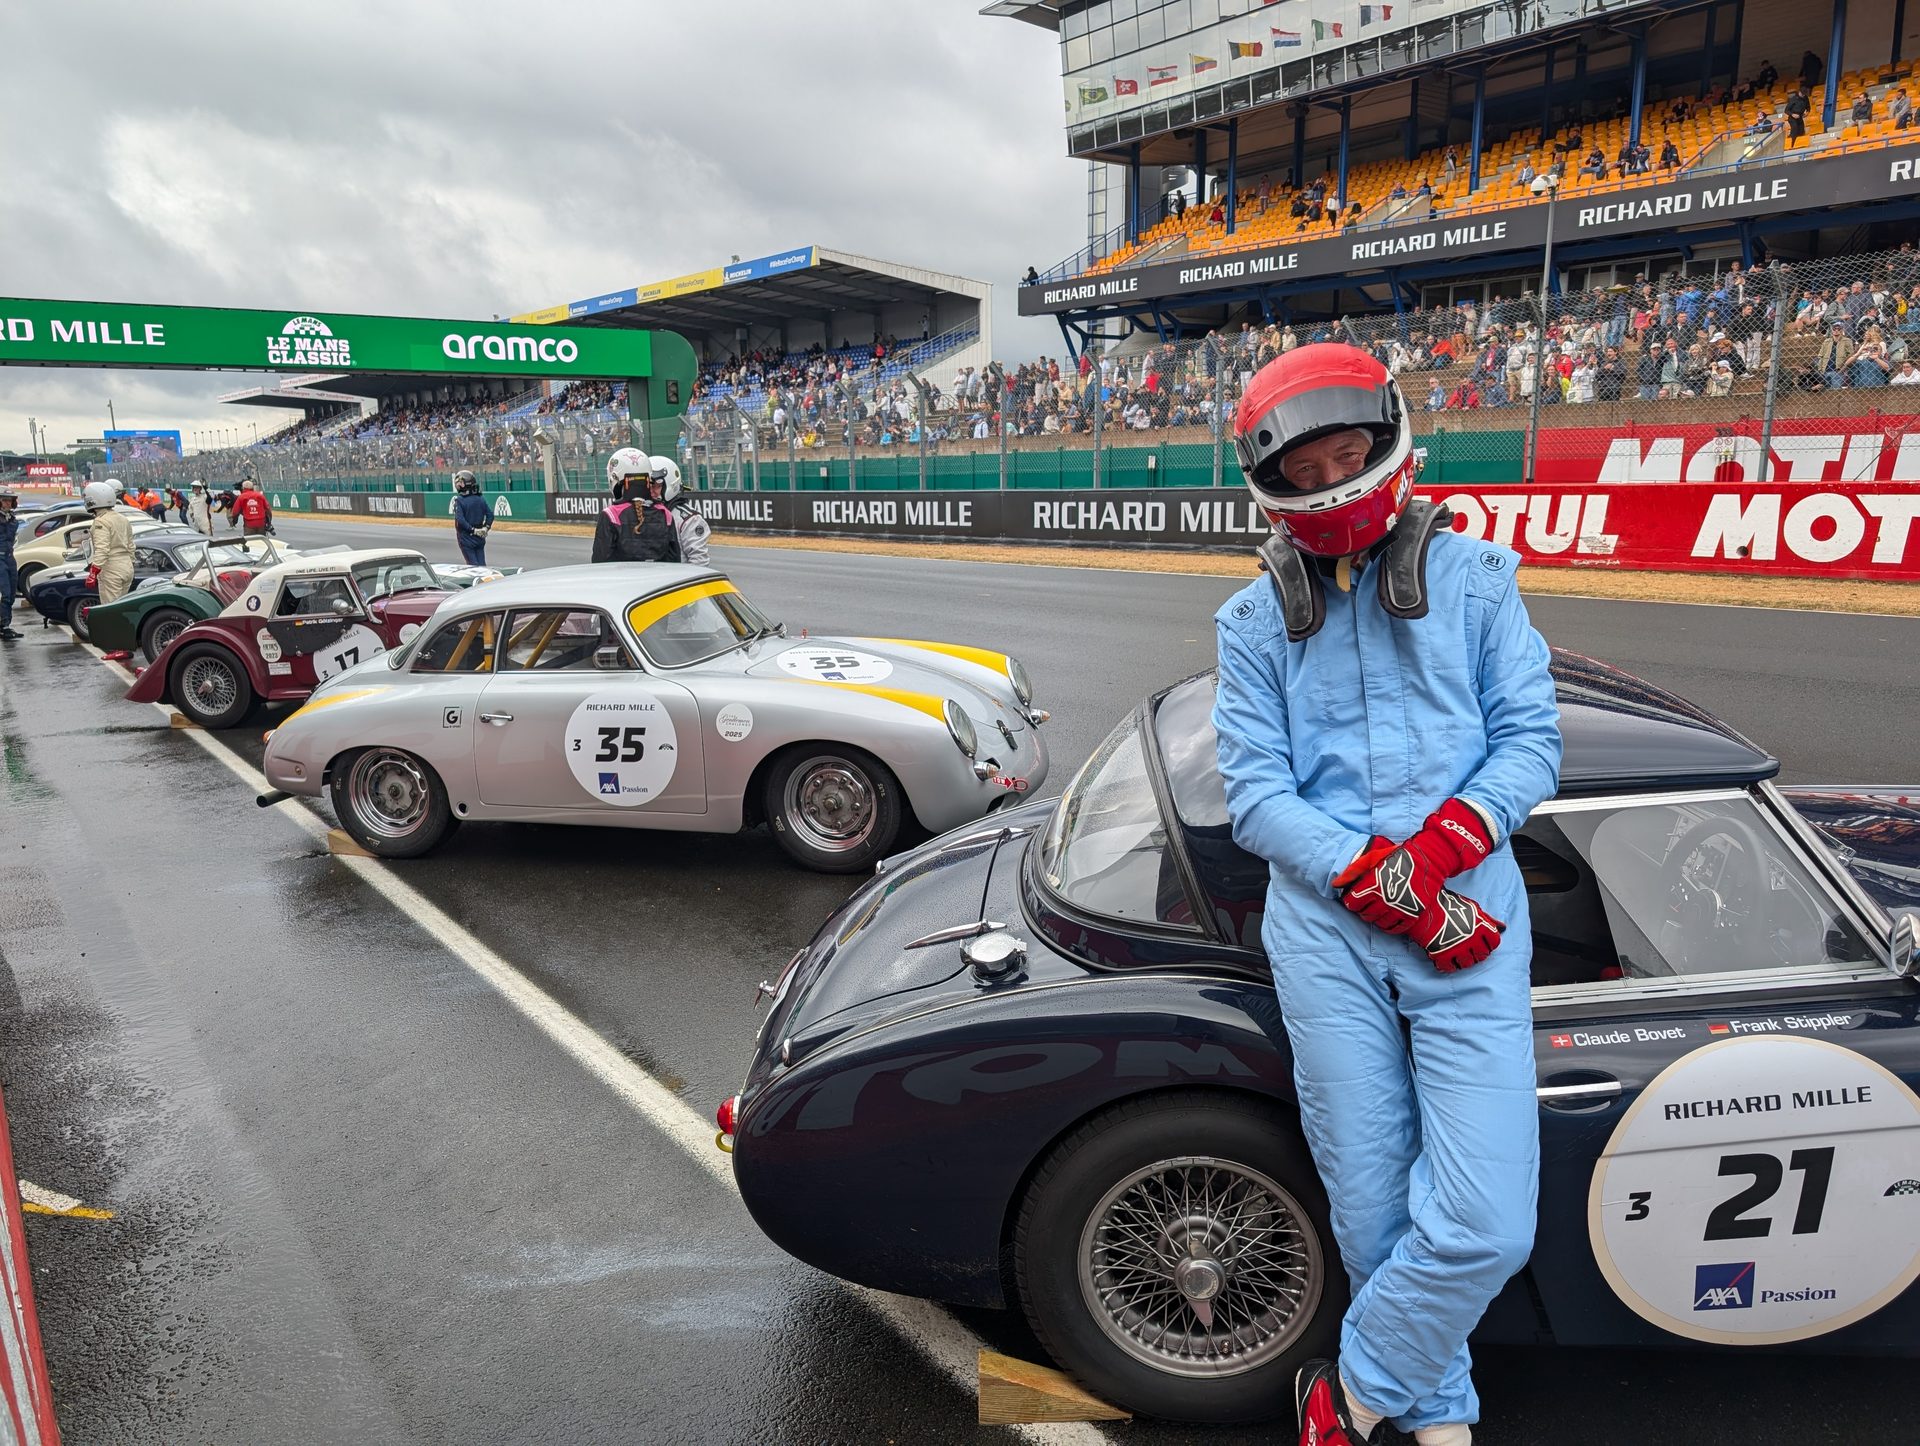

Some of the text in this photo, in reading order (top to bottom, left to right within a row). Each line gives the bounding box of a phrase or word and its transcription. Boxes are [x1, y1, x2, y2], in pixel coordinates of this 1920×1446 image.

[1578, 178, 1788, 227] RICHARD MILLE
[1352, 221, 1507, 260] RICHARD MILLE
[730, 268, 752, 280] MICHELIN
[1180, 253, 1298, 285] RICHARD MILLE
[643, 288, 661, 298] MICHELIN
[1044, 277, 1138, 304] RICHARD MILLE
[50, 319, 166, 346] MILLE
[267, 337, 350, 352] LE MANS
[442, 334, 578, 363] aramco
[268, 350, 351, 366] CLASSIC
[30, 466, 65, 475] MOTUL
[555, 497, 599, 515] RICHARD
[727, 500, 773, 521] MILLE
[812, 501, 972, 527] RICHARD MILLE
[1033, 501, 1276, 533] RICHARD MILL
[1412, 493, 1619, 555] OTUL
[1690, 492, 1920, 564] MOT
[334, 646, 360, 671] 17
[809, 656, 861, 670] 35
[446, 710, 459, 725] G
[586, 703, 656, 712] RICHARD MILLE
[572, 738, 582, 752] 3
[595, 726, 647, 763] 35
[600, 782, 618, 793] AXA
[621, 785, 649, 794] Passion
[1730, 1013, 1852, 1034] Frank Stippler
[1573, 1026, 1687, 1048] Claude Bovet
[1664, 1085, 1873, 1121] RICHARD MILLE
[1703, 1146, 1836, 1242] 21
[1624, 1191, 1652, 1222] 3
[1694, 1286, 1743, 1307] AXA
[1760, 1286, 1837, 1304] Passion
